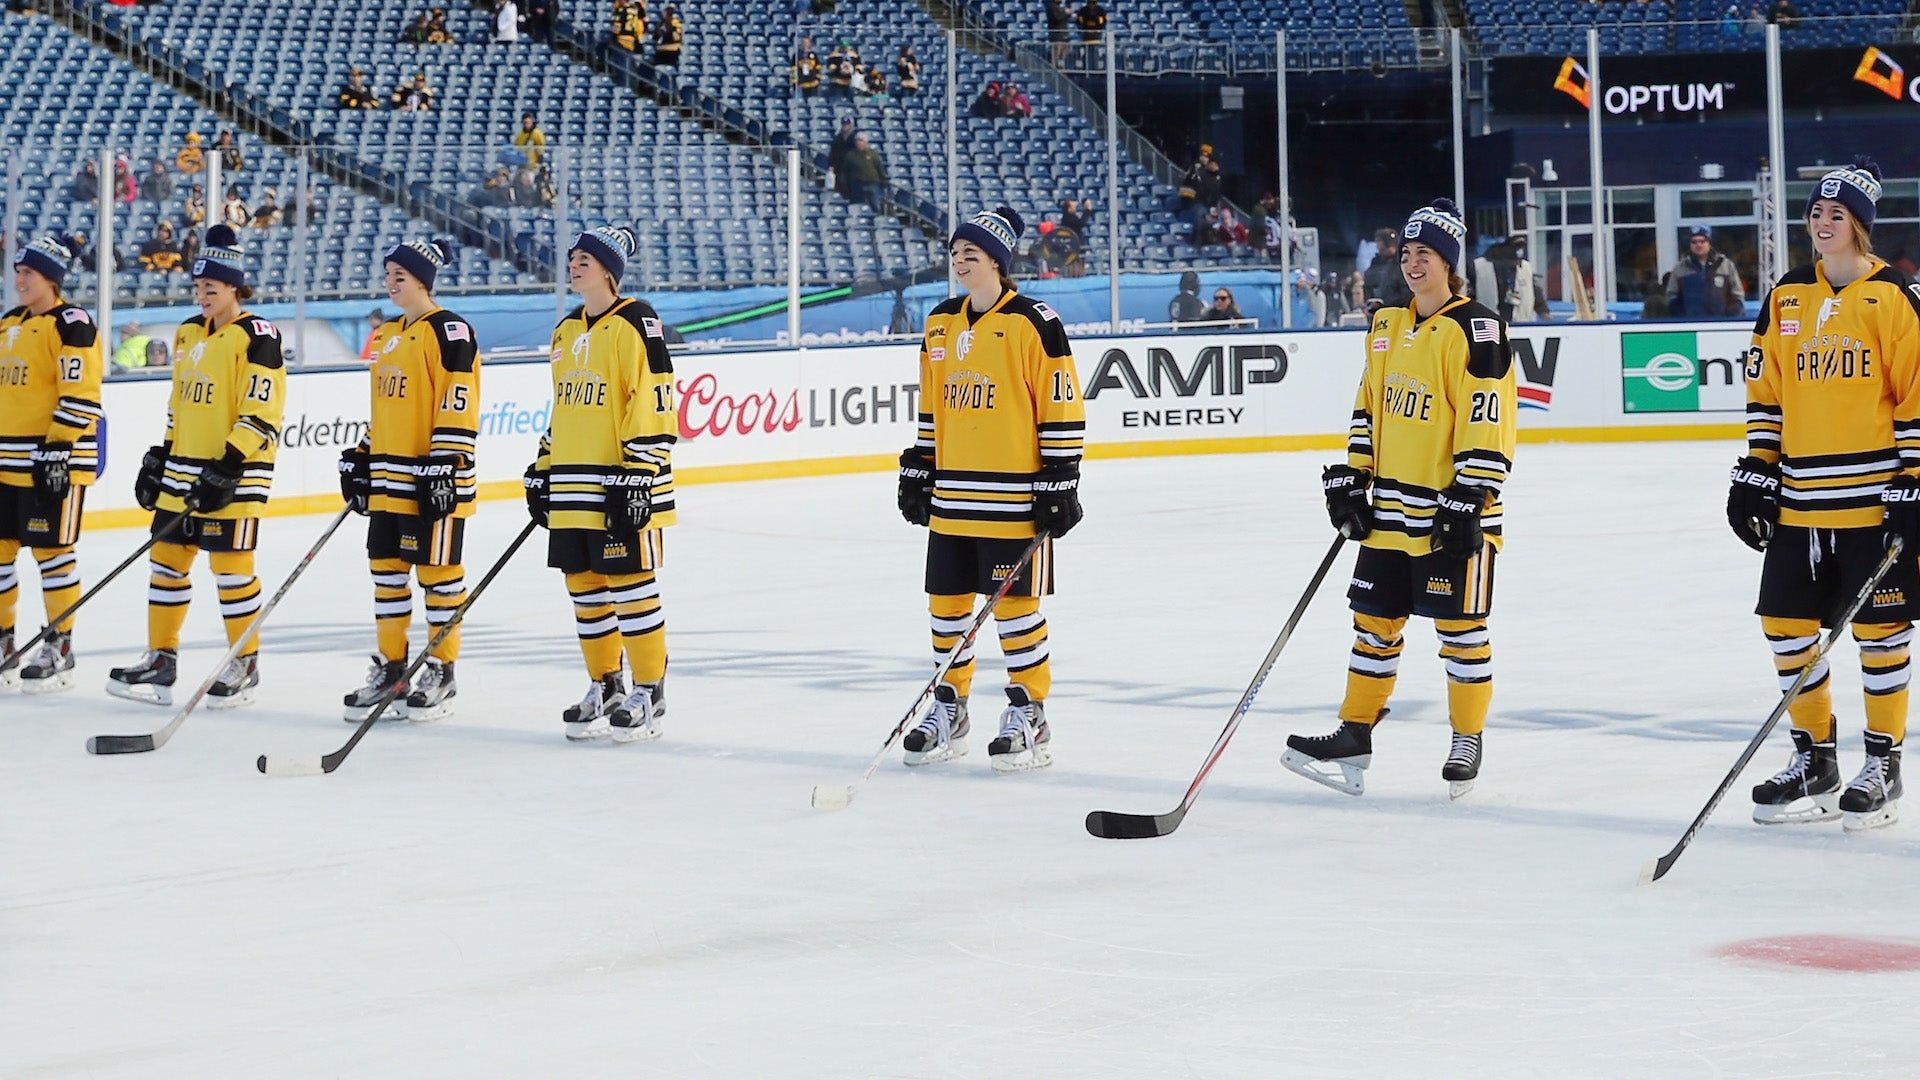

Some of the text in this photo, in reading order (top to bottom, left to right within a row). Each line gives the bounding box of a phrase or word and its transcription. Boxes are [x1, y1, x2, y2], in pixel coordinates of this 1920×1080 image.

[1605, 83, 1723, 114] OPTUM
[1801, 334, 1862, 352] BOSTON
[60, 357, 81, 380] 12
[1084, 345, 1288, 400] AMP
[248, 374, 272, 402] 13
[1052, 371, 1074, 401] 18
[441, 386, 468, 411] 15
[676, 374, 920, 439] Coors LIGHT
[1470, 392, 1499, 423] 20
[1123, 408, 1245, 427] ENERGY
[1033, 479, 1078, 491] BAUER
[1881, 488, 1920, 502] BAU
[1427, 580, 1453, 593] NWHL
[1873, 591, 1906, 605] NWHL
